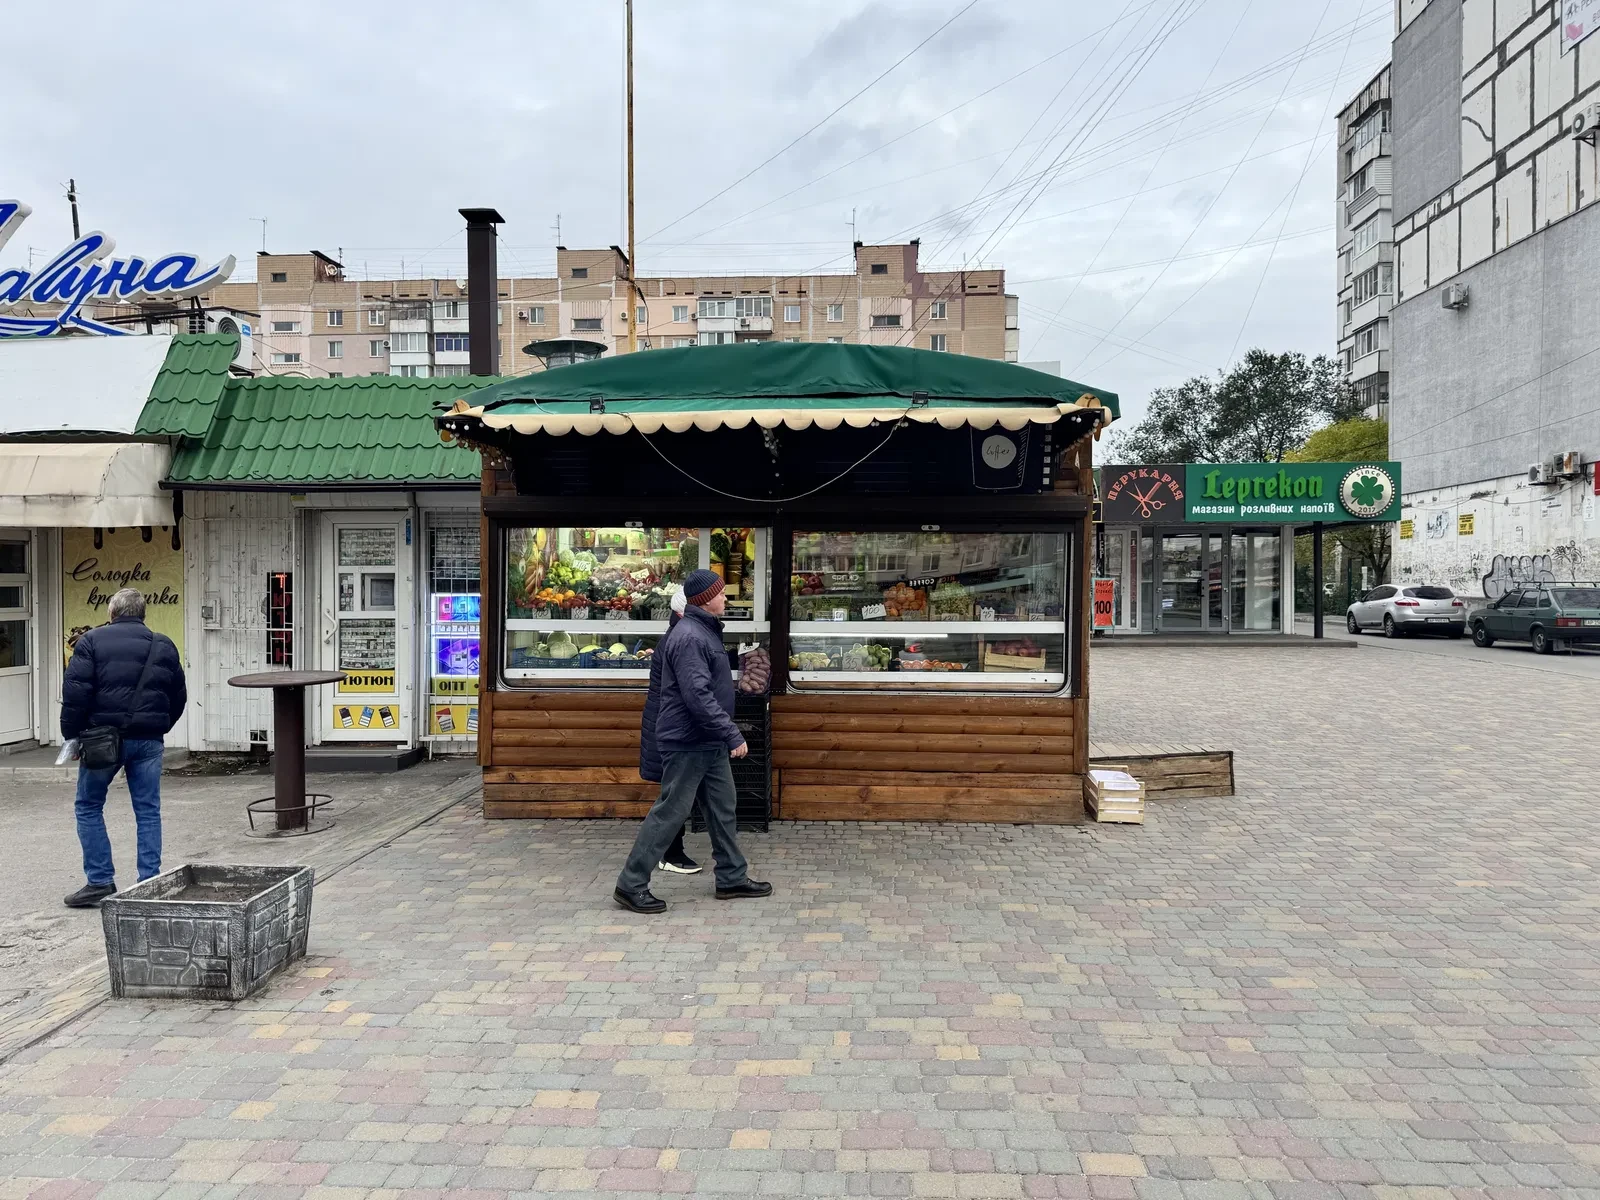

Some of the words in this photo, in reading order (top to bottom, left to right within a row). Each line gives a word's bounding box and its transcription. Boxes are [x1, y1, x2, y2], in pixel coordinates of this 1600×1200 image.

[1356, 469, 1381, 477] since
[1107, 468, 1184, 501] ПЕРУКАРНЯ
[1201, 468, 1324, 504] Leprekon
[1192, 505, 1235, 515] магазин
[1240, 503, 1294, 517] розливних
[1300, 502, 1335, 514] напоїв
[65, 558, 151, 587] Солодка
[87, 586, 179, 610] краичка
[1094, 600, 1112, 614] 100
[273, 574, 292, 662] ТЮТЮН
[864, 606, 880, 616] 100
[439, 681, 467, 691] ОПТ
